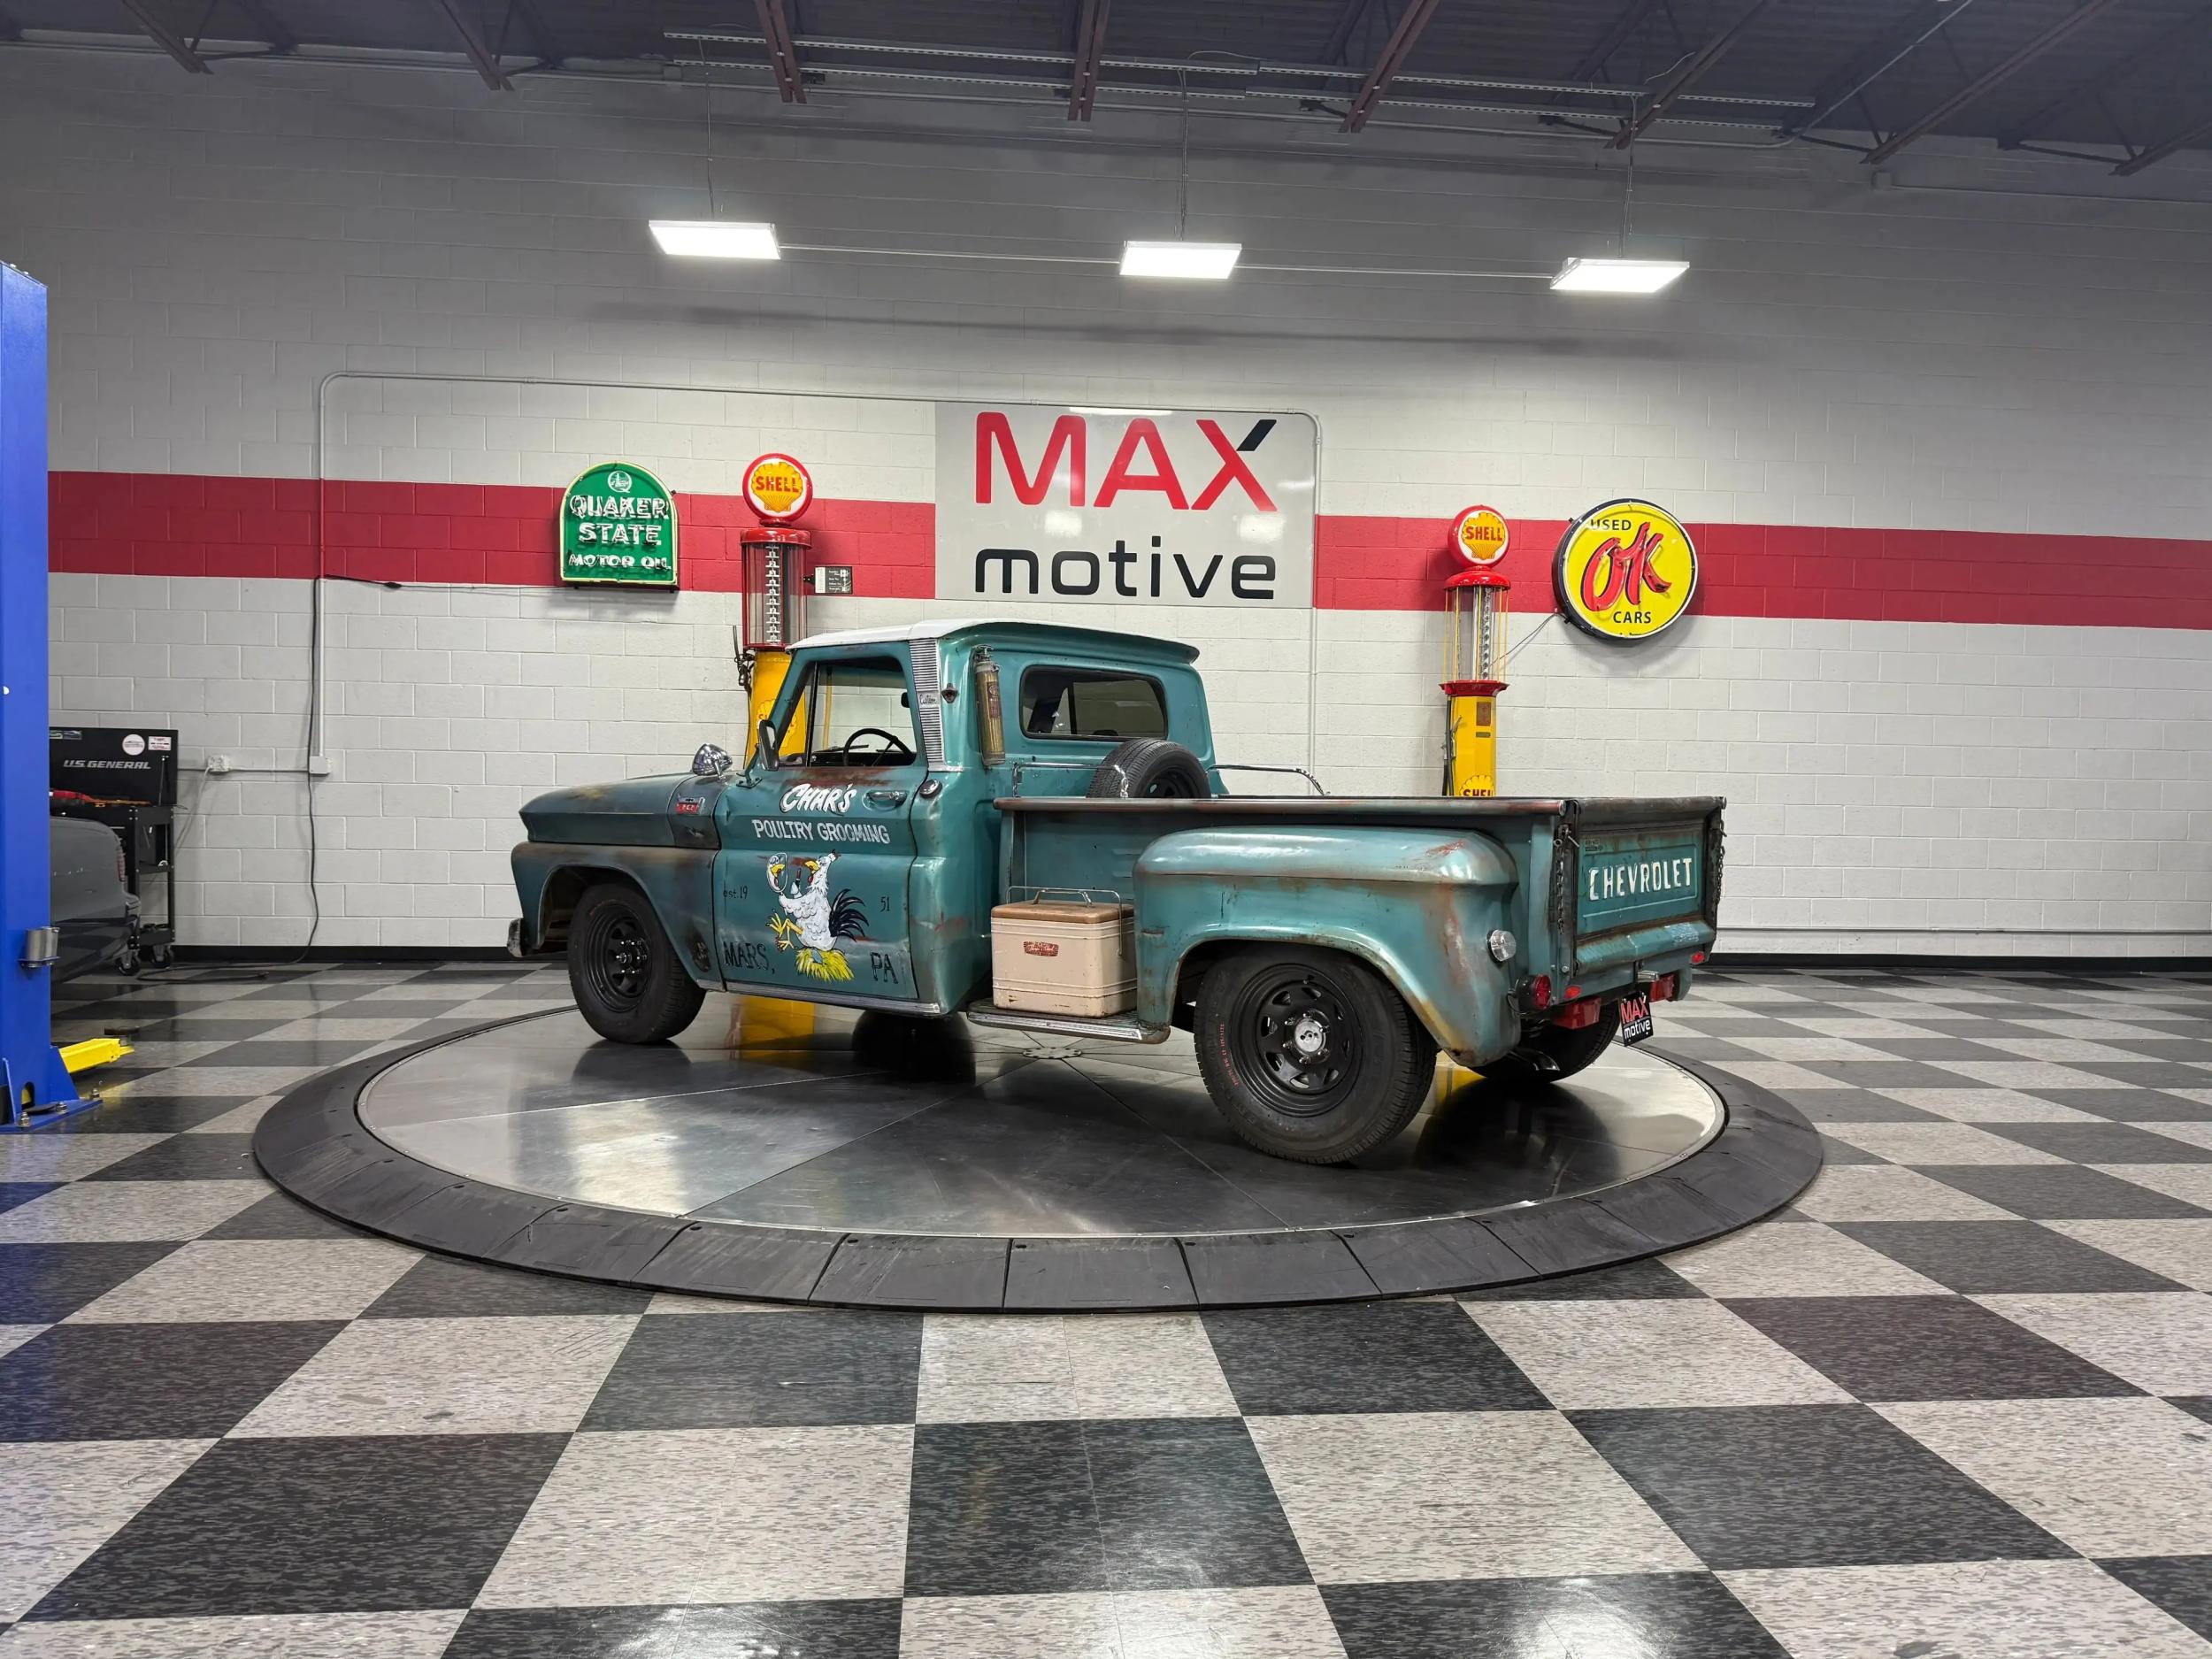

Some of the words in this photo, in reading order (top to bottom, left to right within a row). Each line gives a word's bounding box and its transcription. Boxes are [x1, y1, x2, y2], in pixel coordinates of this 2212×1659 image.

[975, 411, 1278, 512] MAX
[755, 476, 800, 493] SHELL
[570, 495, 670, 519] QUAKER
[579, 522, 662, 545] STATE
[1464, 525, 1503, 542] SHELL
[1590, 518, 1632, 532] USED
[568, 553, 635, 567] MOTOR
[641, 555, 672, 570] OIL
[974, 535, 1277, 600] motive
[1580, 521, 1671, 612] OK
[1613, 611, 1652, 624] CARS
[87, 761, 151, 770] GENERAL
[752, 819, 813, 841] POULTRY
[817, 823, 890, 844] GROOMING
[1589, 858, 1693, 901] CHEVROLET
[880, 896, 890, 912] 51
[723, 941, 775, 974] MARS,
[870, 952, 899, 984] PA
[1620, 998, 1649, 1025] MAX
[1624, 1018, 1652, 1040] motive
